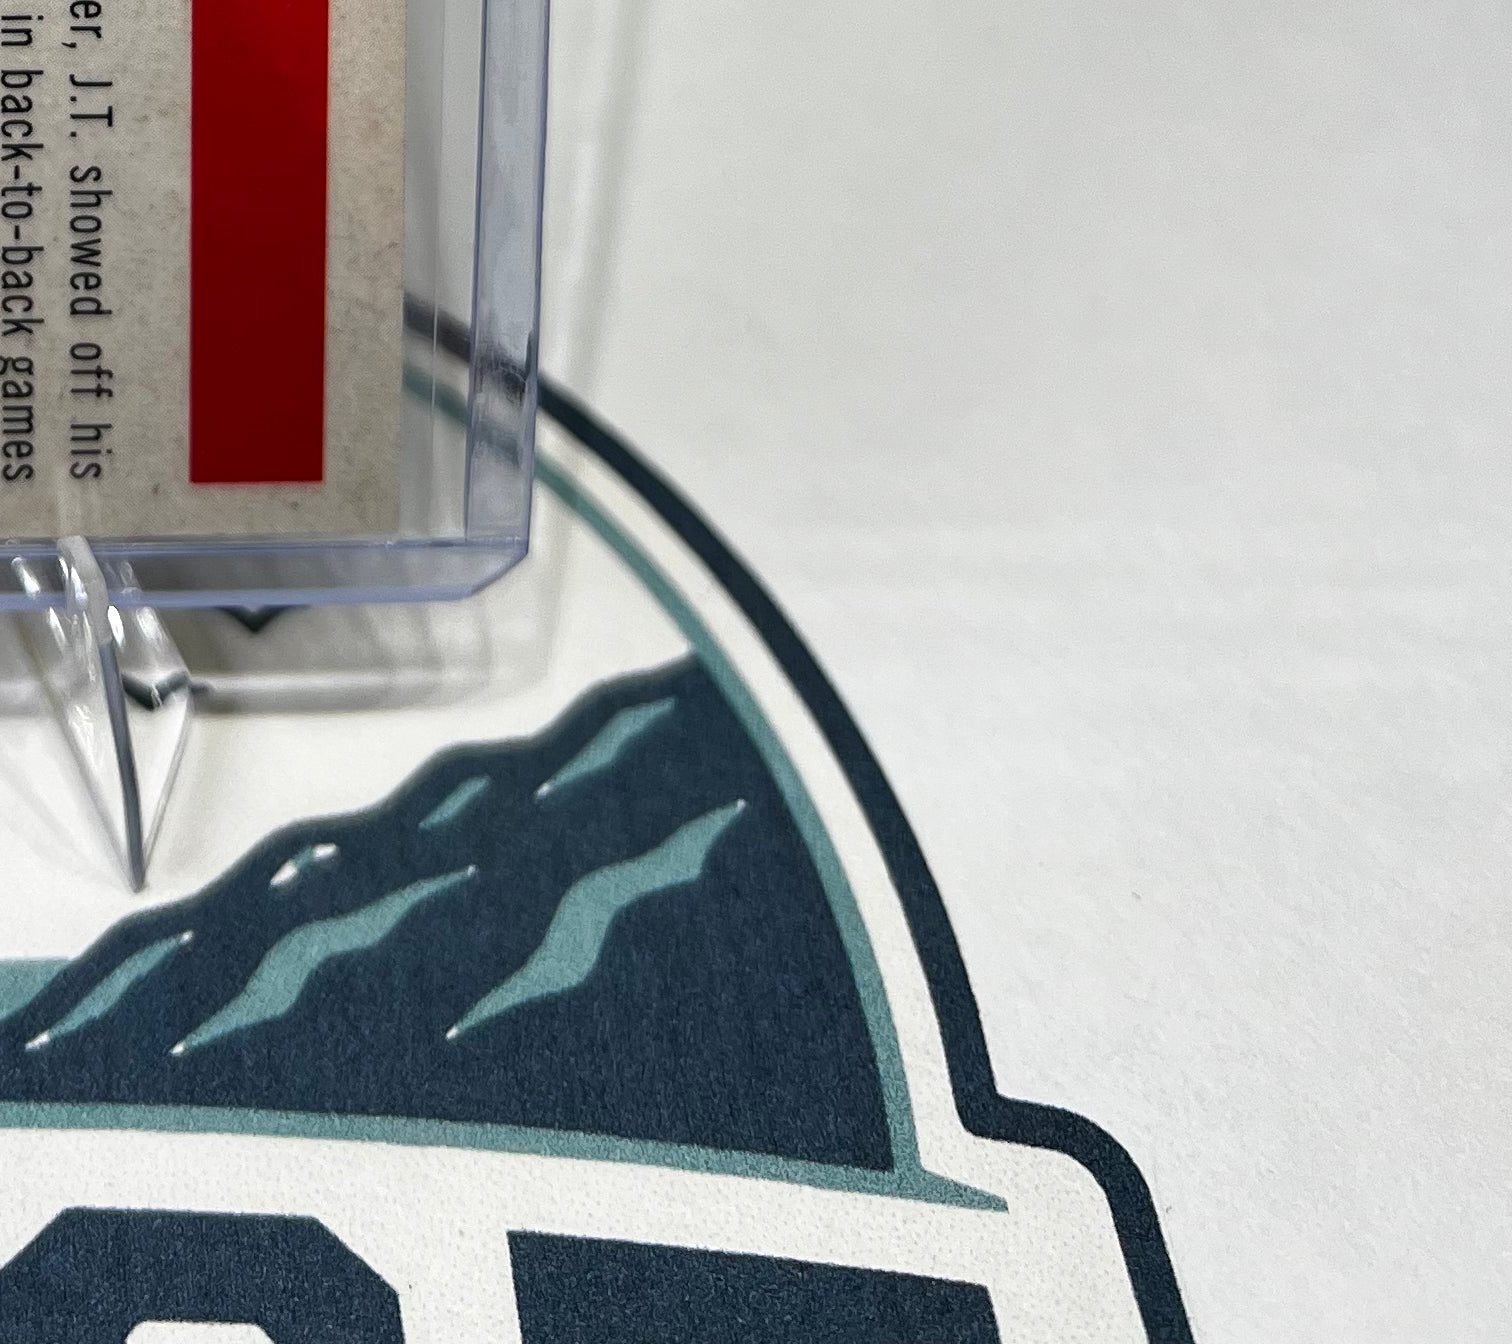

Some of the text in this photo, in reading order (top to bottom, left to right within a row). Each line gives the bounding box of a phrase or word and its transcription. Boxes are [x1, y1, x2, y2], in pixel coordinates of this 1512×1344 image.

[68, 73, 114, 138] J.T.
[68, 165, 114, 316] showed
[68, 342, 114, 399] off
[68, 423, 113, 480] his
